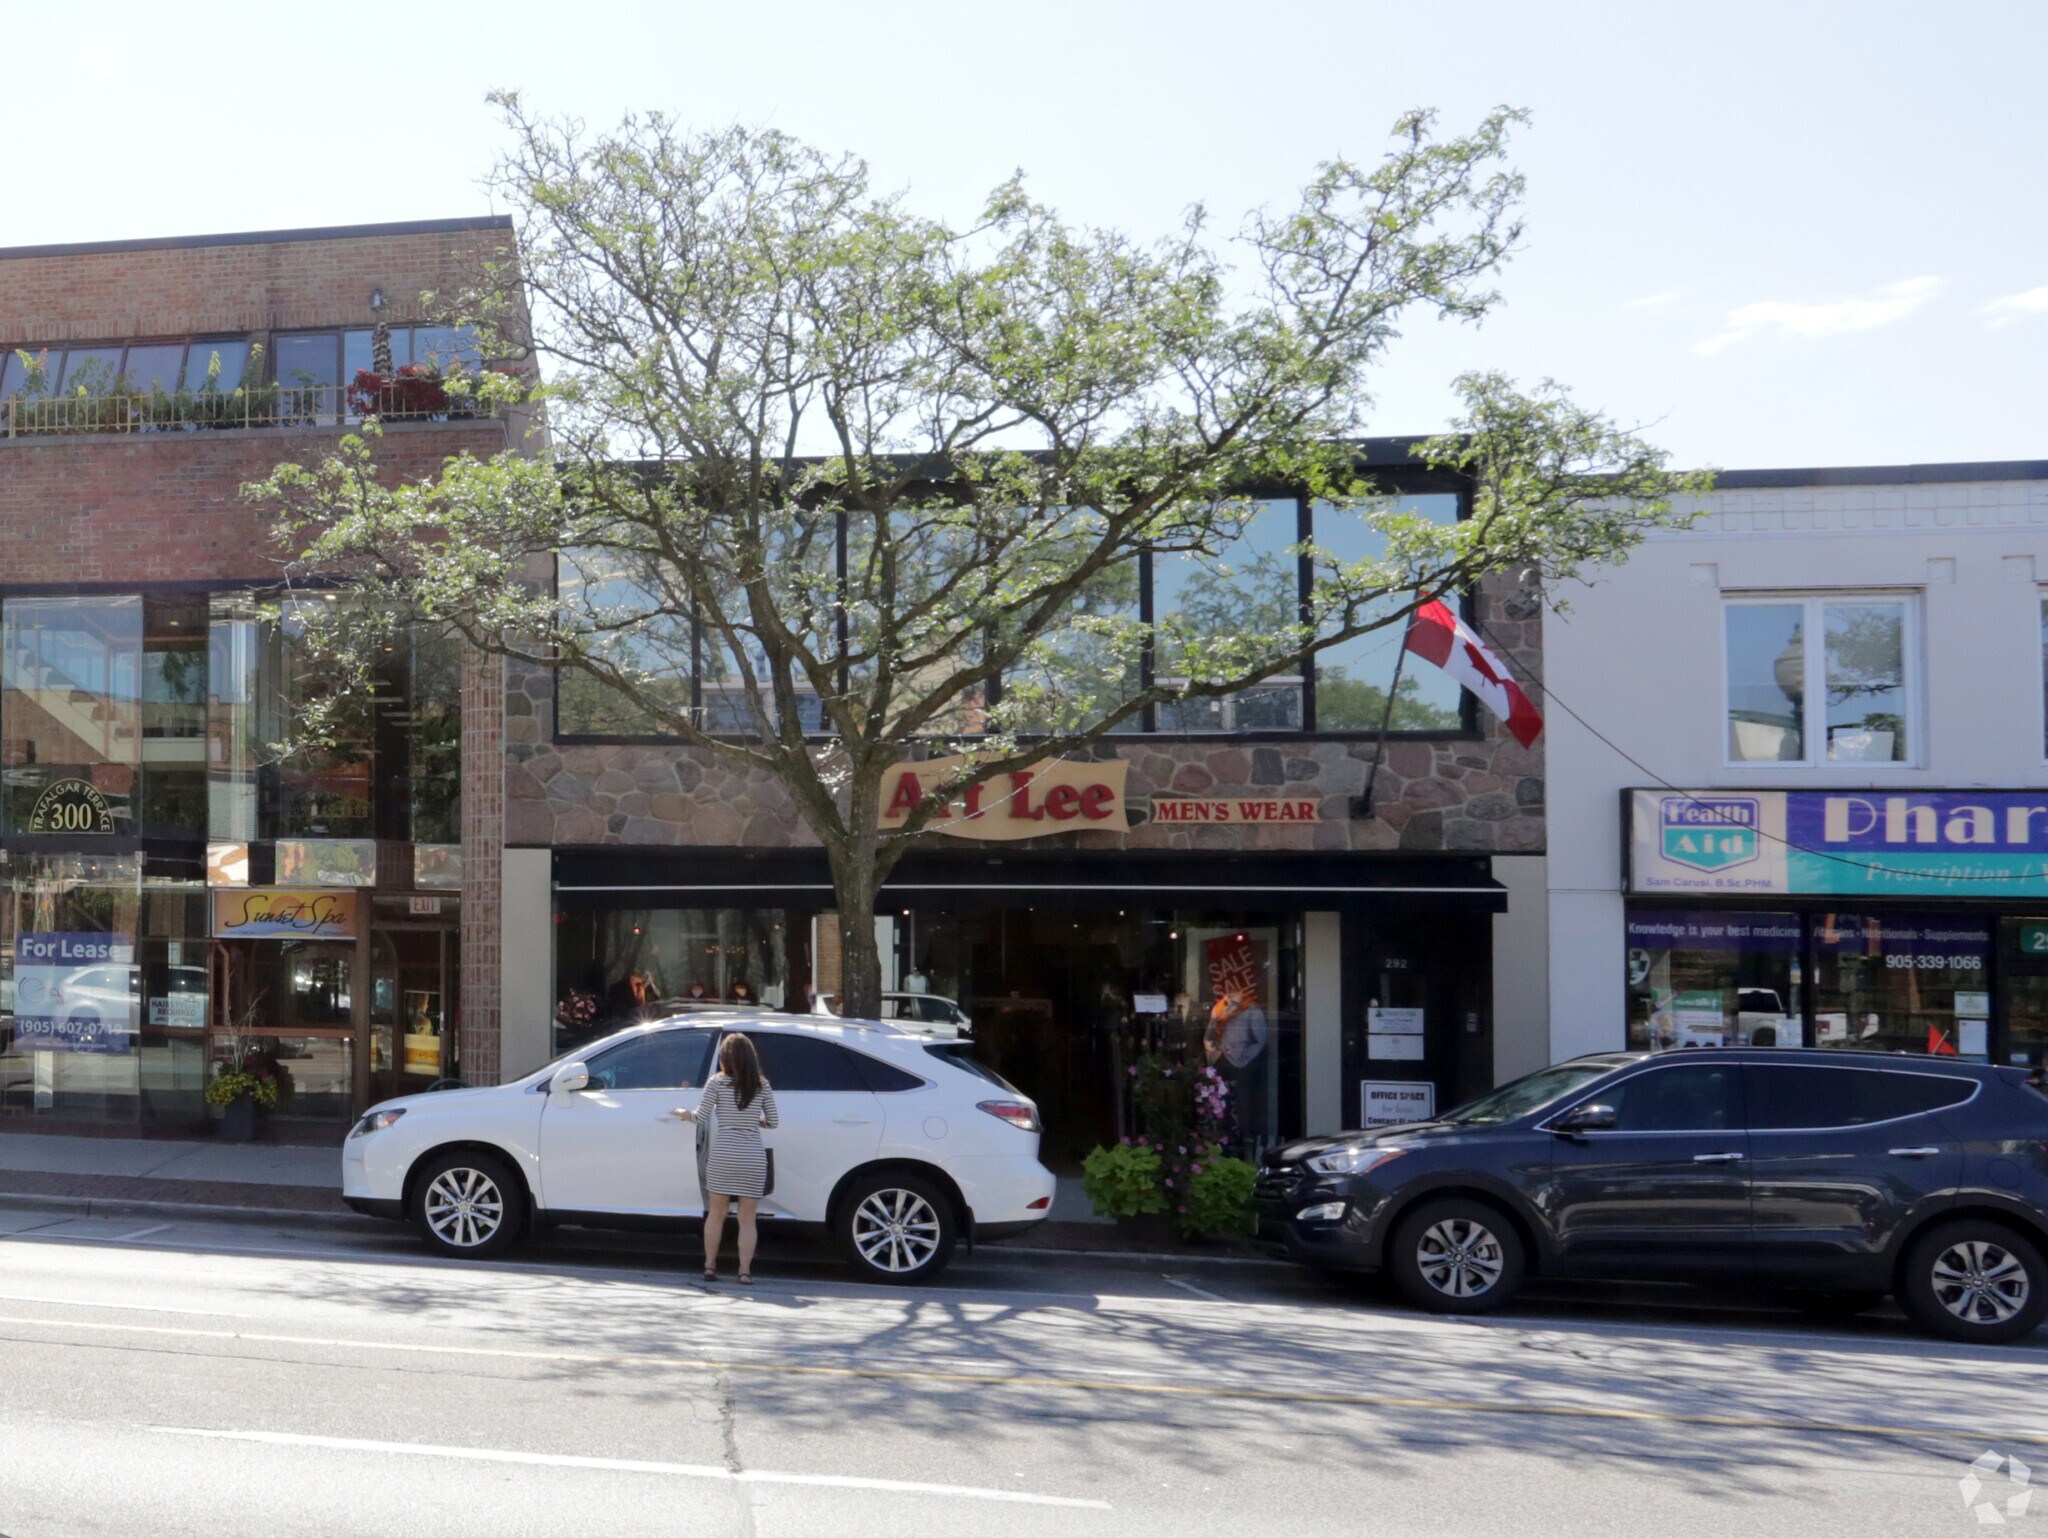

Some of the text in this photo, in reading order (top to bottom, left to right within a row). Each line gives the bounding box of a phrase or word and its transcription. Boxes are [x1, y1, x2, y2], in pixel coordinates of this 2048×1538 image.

[1008, 771, 1115, 820] Lee
[34, 782, 110, 831] TRAFALGAR TERRACE
[1158, 802, 1315, 821] MEN'S WEAR
[51, 803, 92, 830] 300
[1825, 797, 2047, 844] Phar
[1673, 834, 1744, 854] Aid
[1646, 877, 1670, 887] Sam
[1866, 862, 2011, 887] Prescription
[414, 896, 434, 912] EXIT
[225, 895, 347, 934] Sunset Spa
[1628, 922, 1801, 938] Knowledge is your best medicine
[1924, 929, 1989, 941] Supplements
[22, 939, 121, 958] For Lease
[2033, 931, 2048, 950] 2
[1209, 946, 1254, 982] SALE
[1385, 958, 1409, 969] 292
[157, 1008, 197, 1017] REQUIRED
[21, 1020, 55, 1036] (905)
[1371, 1091, 1425, 1101] OFFICE SPACE
[1368, 1116, 1397, 1125] Contact
